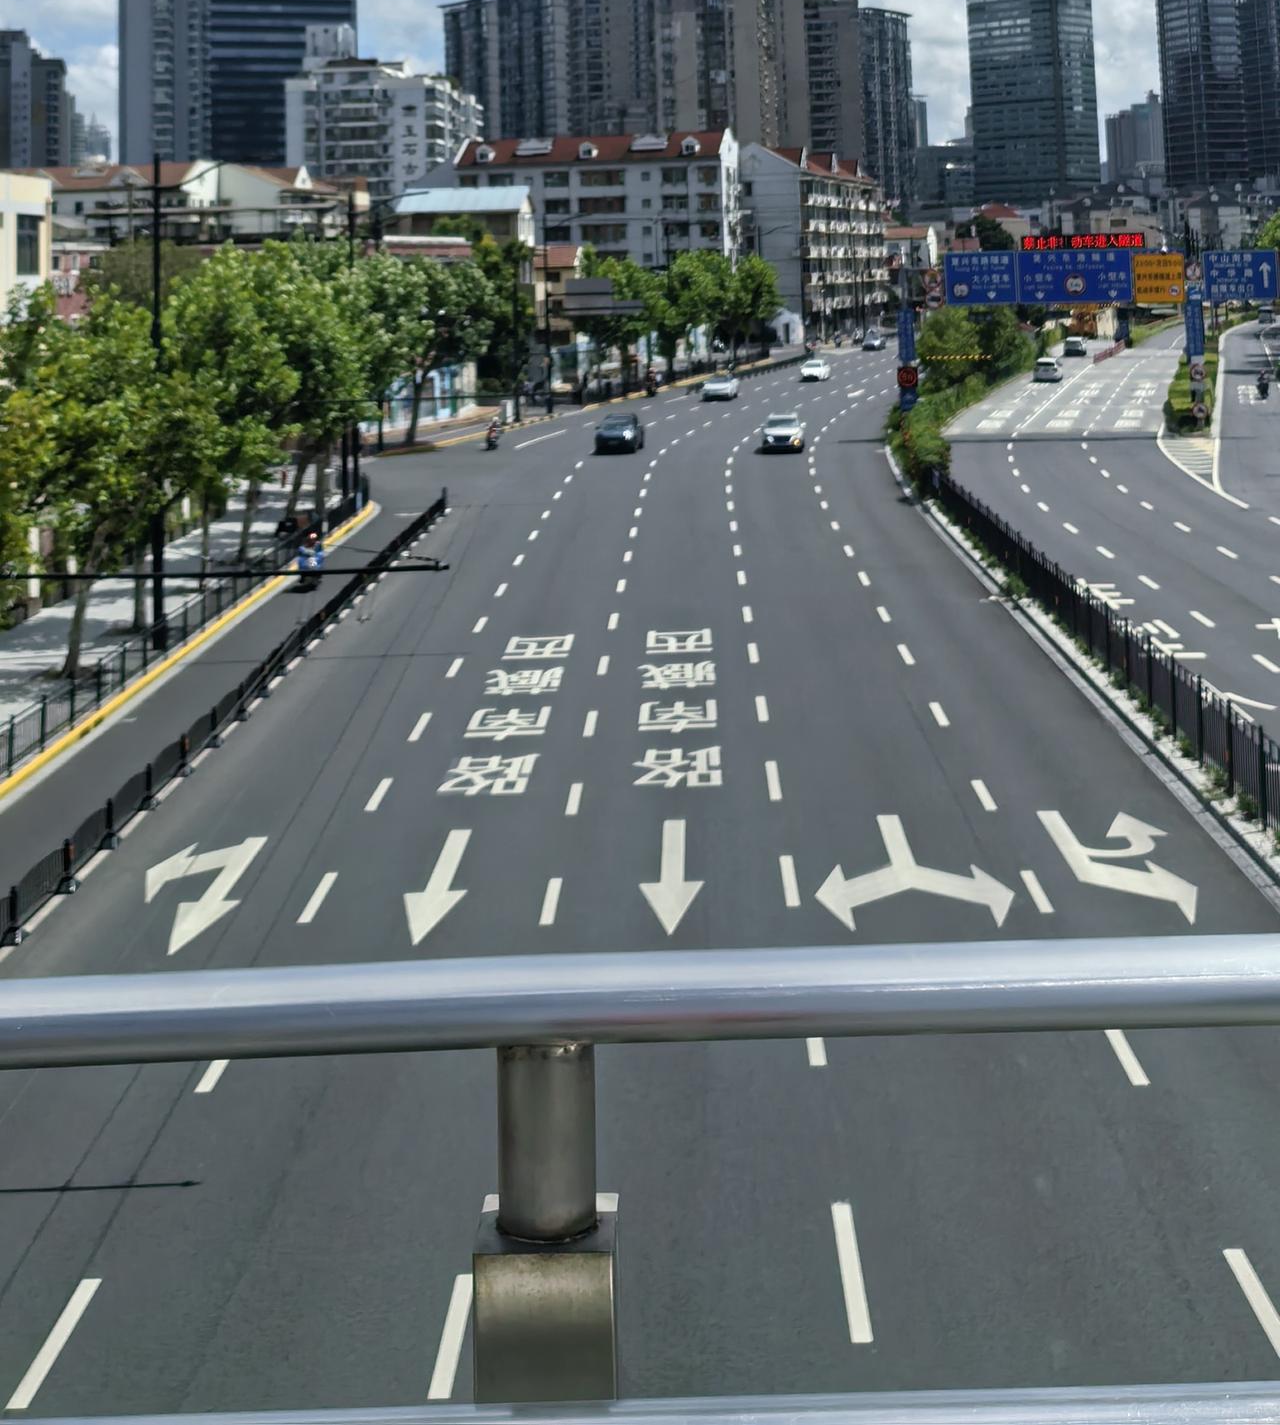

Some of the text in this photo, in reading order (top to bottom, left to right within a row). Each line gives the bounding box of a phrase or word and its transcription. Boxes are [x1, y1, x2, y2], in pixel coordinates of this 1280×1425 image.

[436, 634, 575, 796] 西藏南路
[632, 628, 723, 788] 西藏南路
